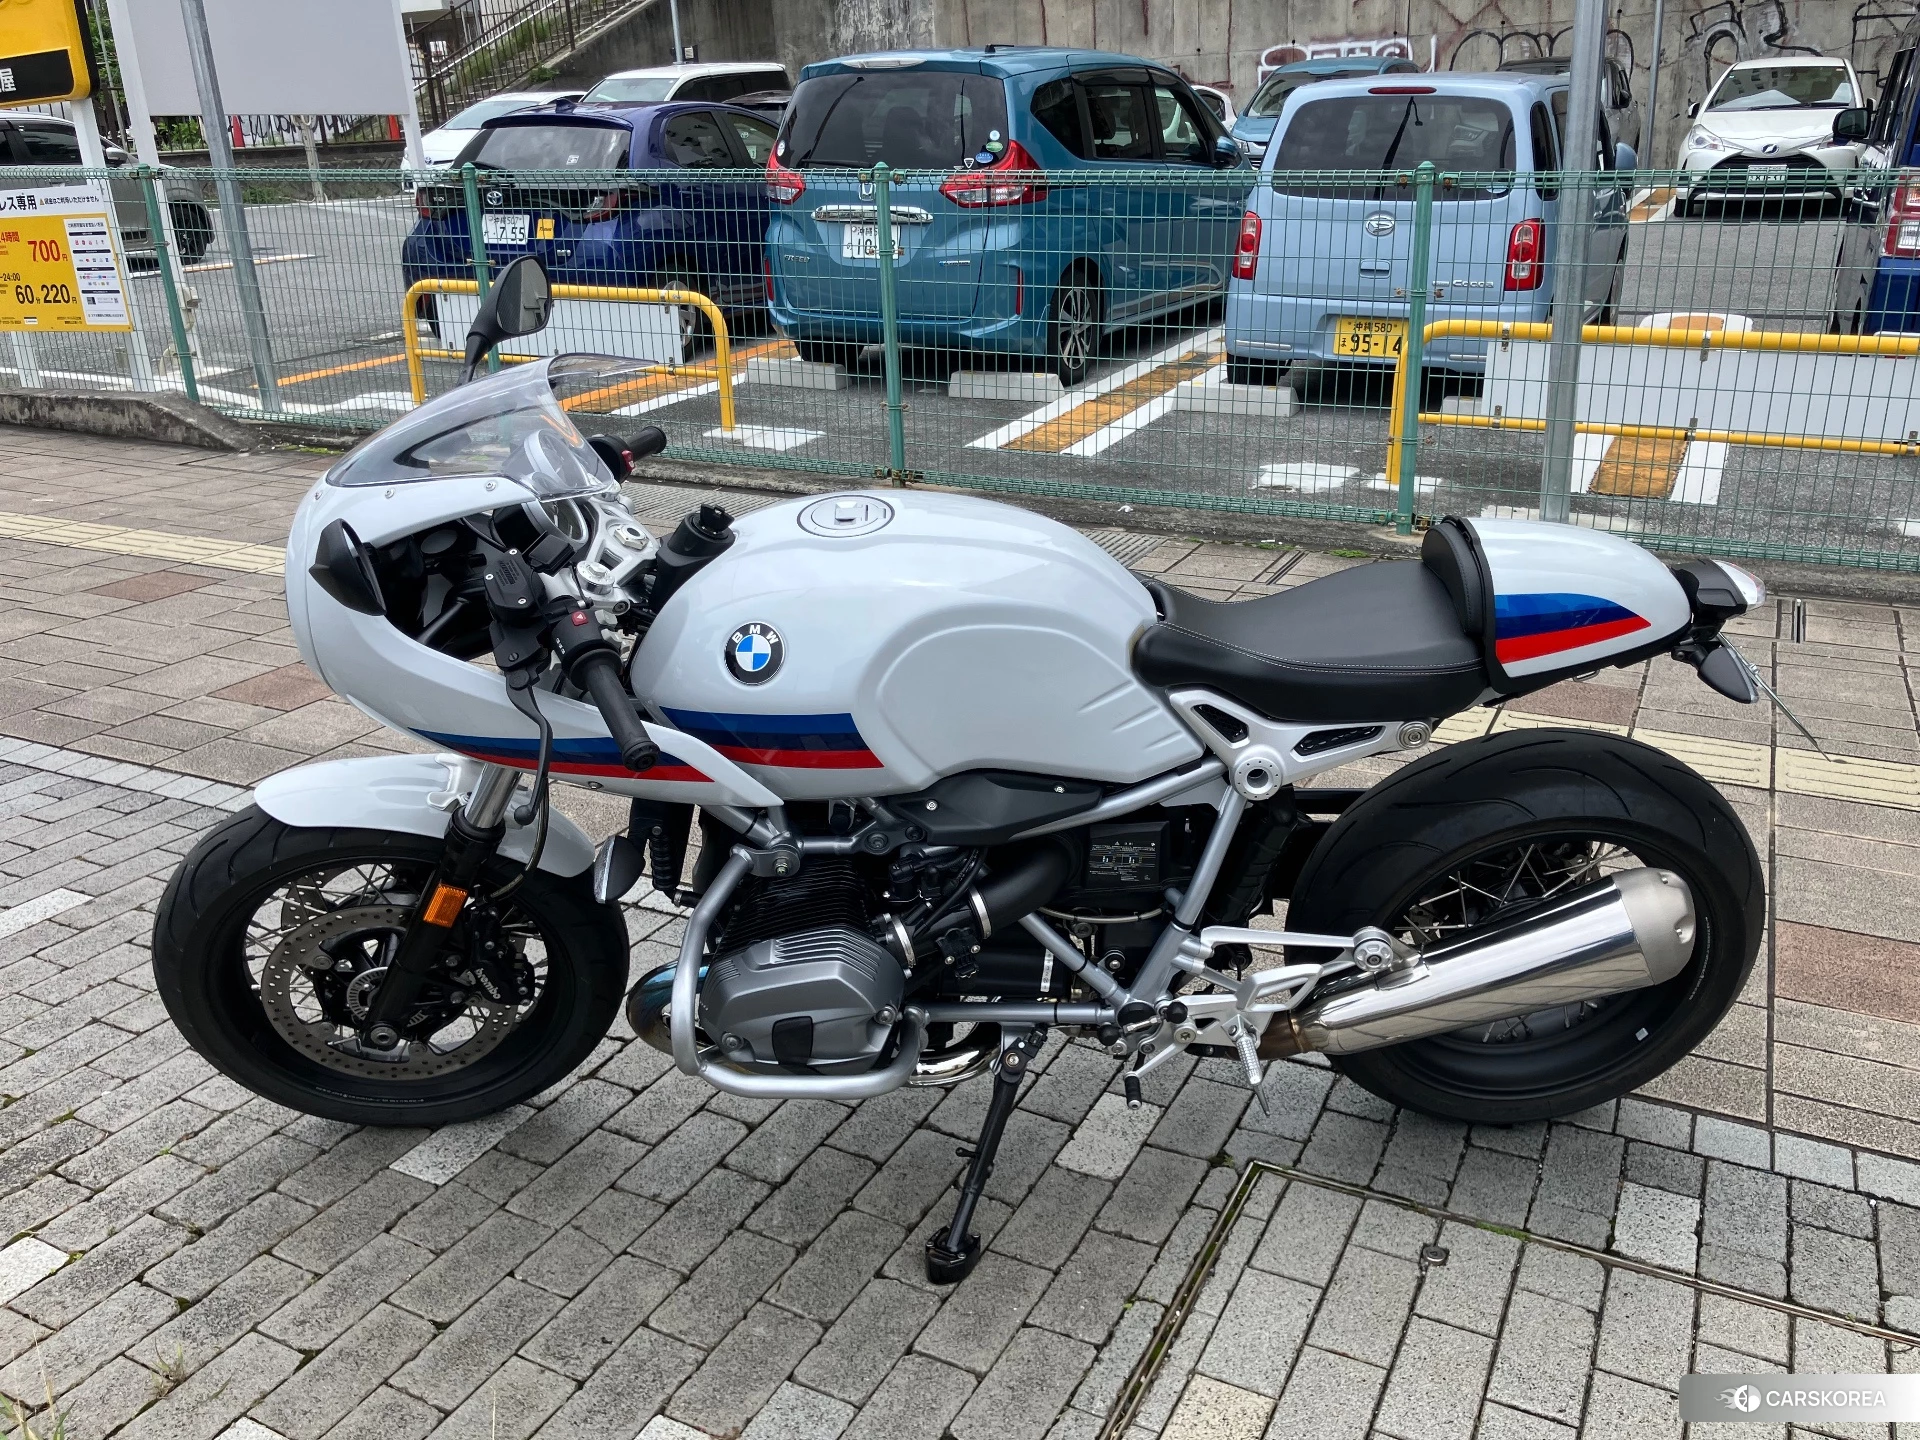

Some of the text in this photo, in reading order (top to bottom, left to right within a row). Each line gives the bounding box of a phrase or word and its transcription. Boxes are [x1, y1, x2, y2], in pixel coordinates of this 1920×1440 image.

[1453, 279, 1495, 289] Cocoa
[731, 624, 780, 645] BMW
[475, 968, 501, 999] brembo
